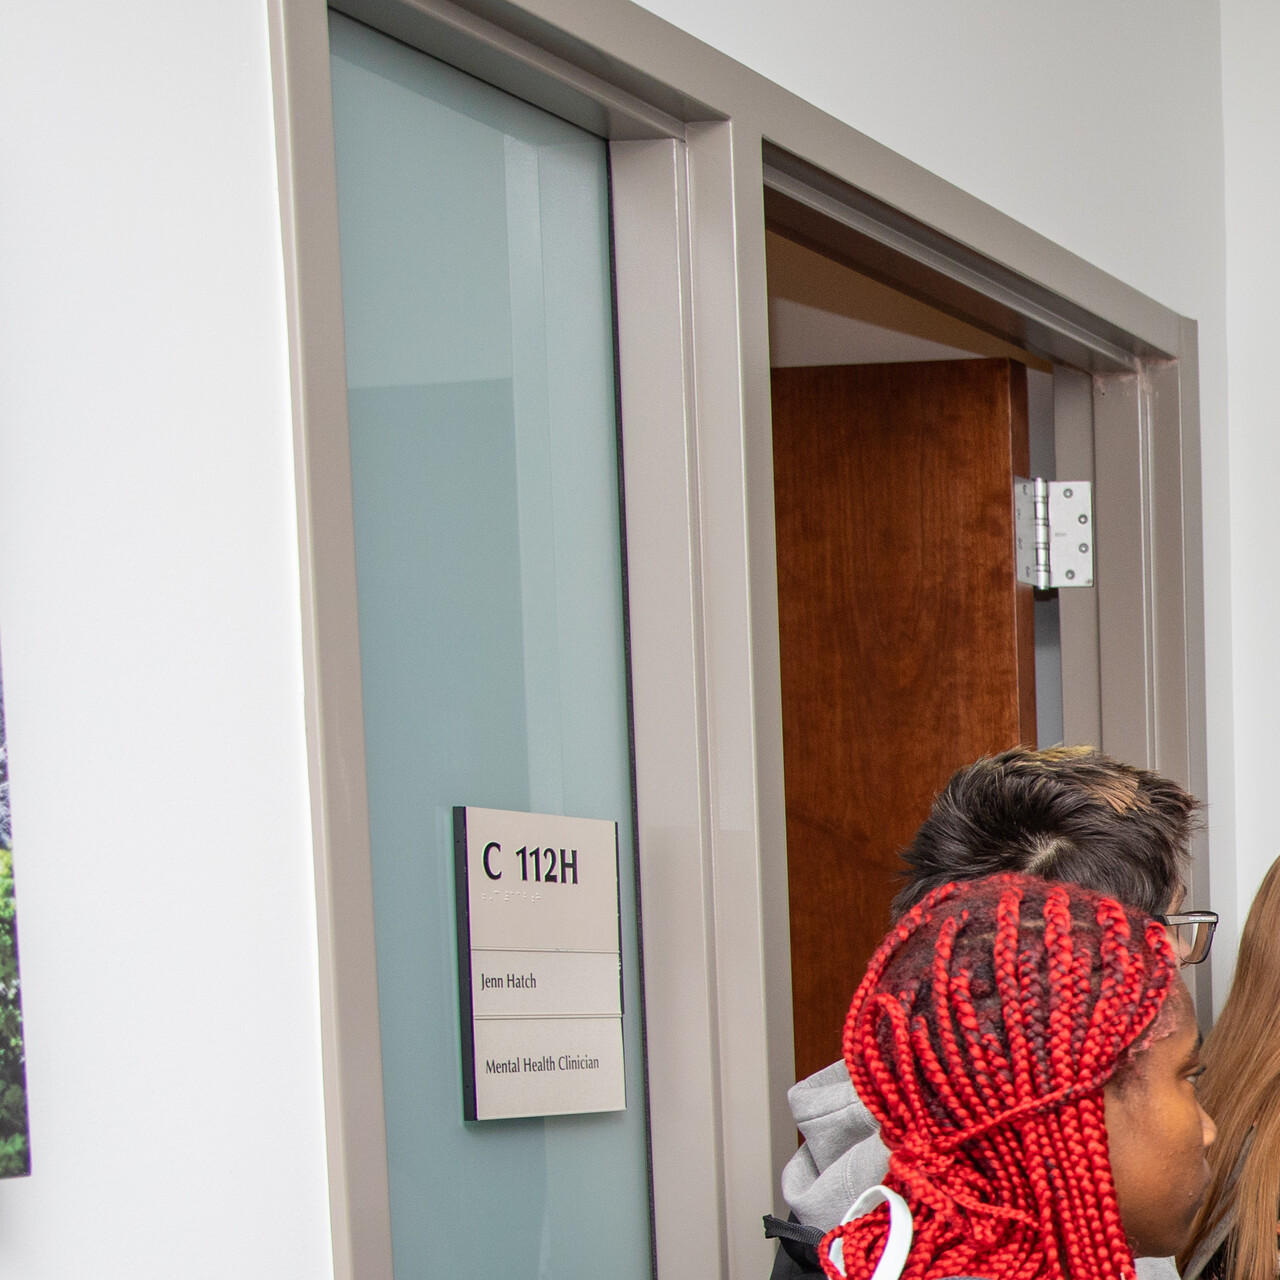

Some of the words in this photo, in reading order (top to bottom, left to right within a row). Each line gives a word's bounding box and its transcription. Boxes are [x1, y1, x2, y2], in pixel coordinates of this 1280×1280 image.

[482, 841, 503, 881] C
[515, 845, 579, 885] 112H
[480, 973, 504, 991] Jenn
[506, 972, 537, 989] Hatch
[485, 1058, 520, 1075] Mental
[523, 1056, 556, 1073] Health
[558, 1054, 600, 1072] Clinician
